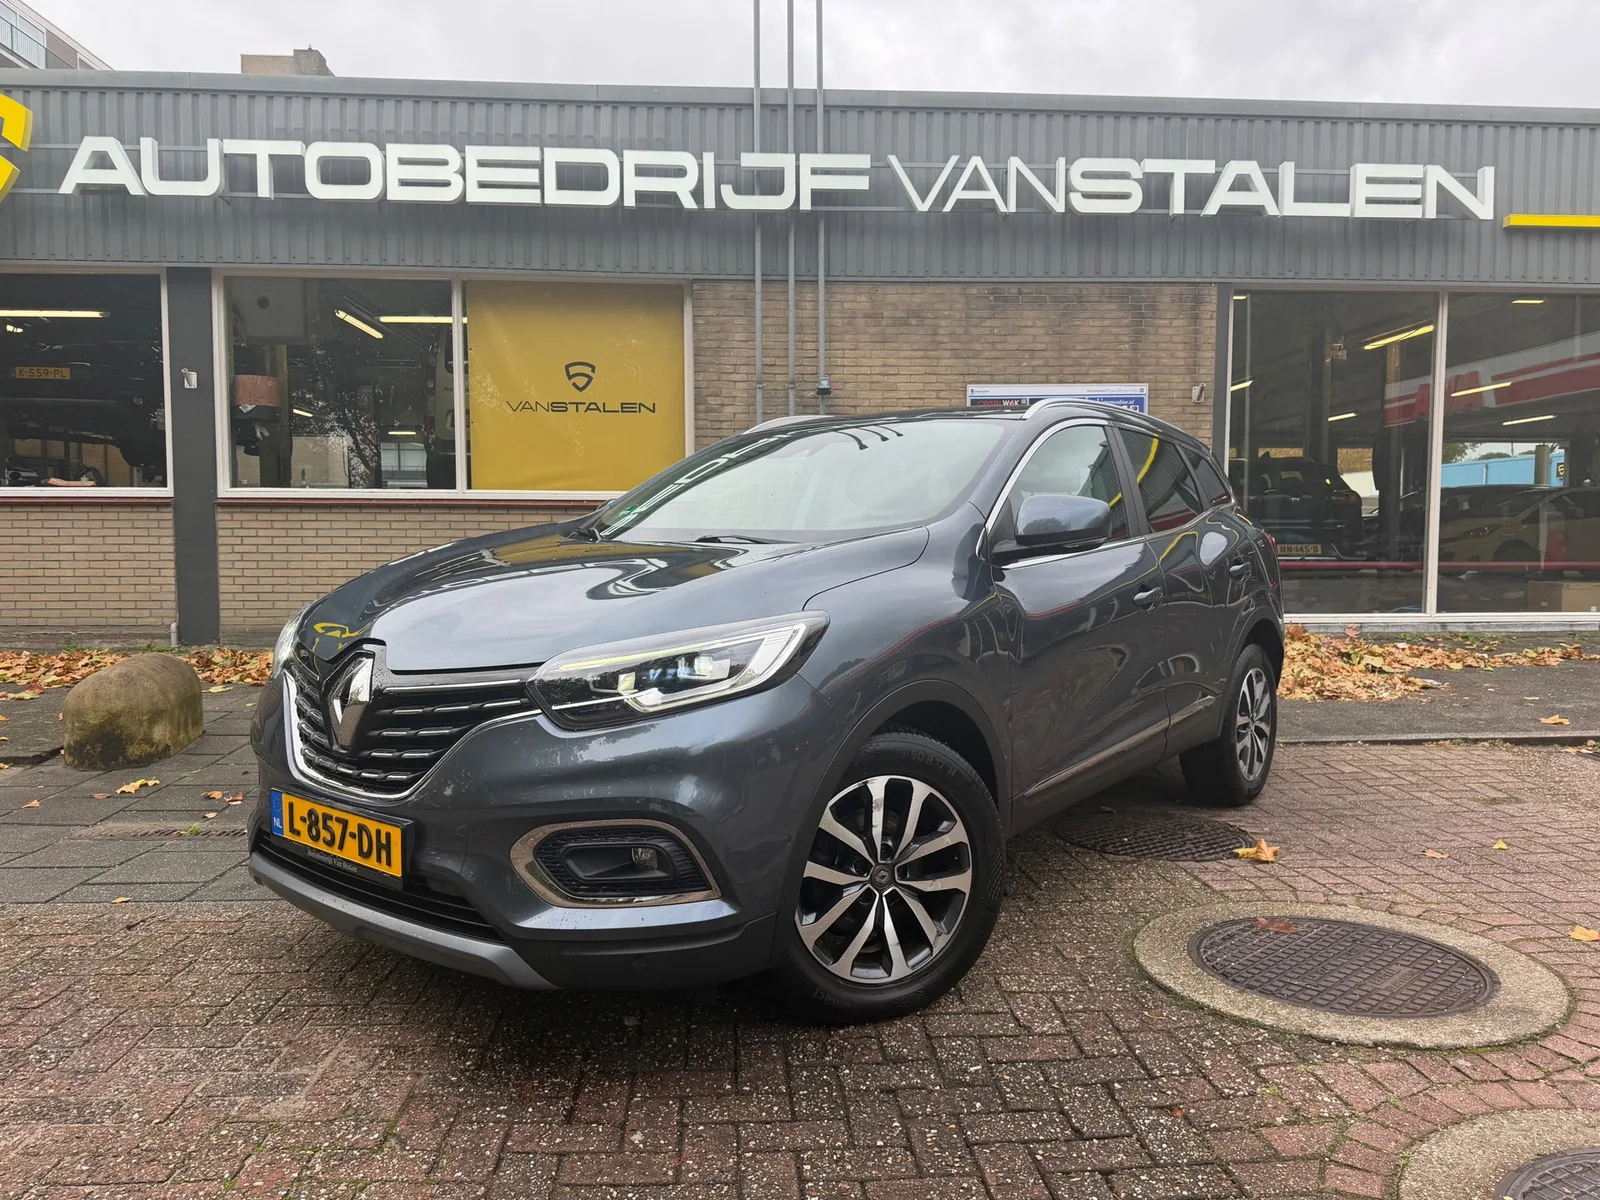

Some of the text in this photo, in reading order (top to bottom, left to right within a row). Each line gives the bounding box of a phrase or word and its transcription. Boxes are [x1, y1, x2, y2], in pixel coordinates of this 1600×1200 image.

[59, 135, 871, 211] AUTOBEDRIJF
[18, 368, 67, 378] K-559-PL
[506, 401, 656, 414] VANSTALEN
[273, 816, 283, 829] NL
[288, 801, 392, 867] L-857-DH
